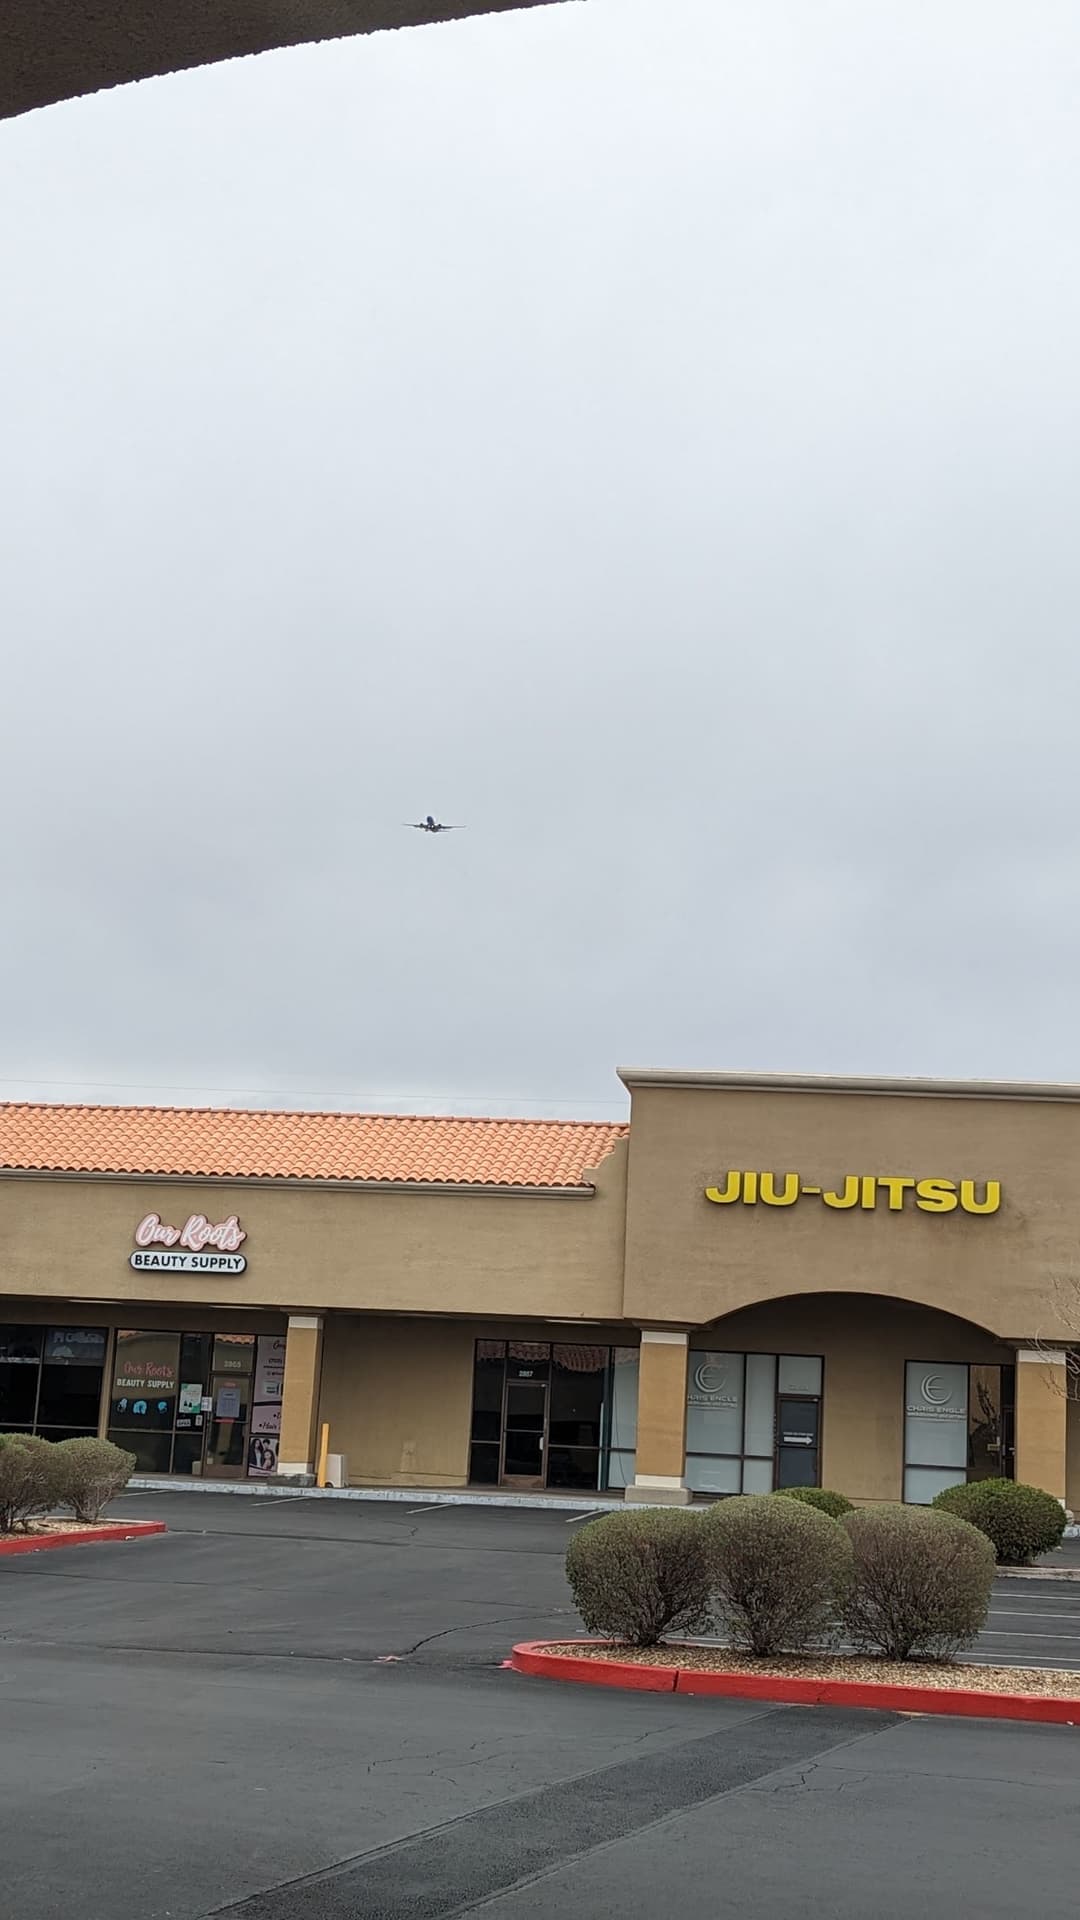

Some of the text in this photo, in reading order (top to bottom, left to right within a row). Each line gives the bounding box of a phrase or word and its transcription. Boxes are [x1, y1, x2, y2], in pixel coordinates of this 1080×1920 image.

[705, 1170, 1001, 1214] JIU-JITSU
[136, 1212, 246, 1251] Our Roots
[134, 1254, 242, 1269] BEAUTY SUPPLY
[116, 1378, 175, 1389] BEAUTY SUPPLY
